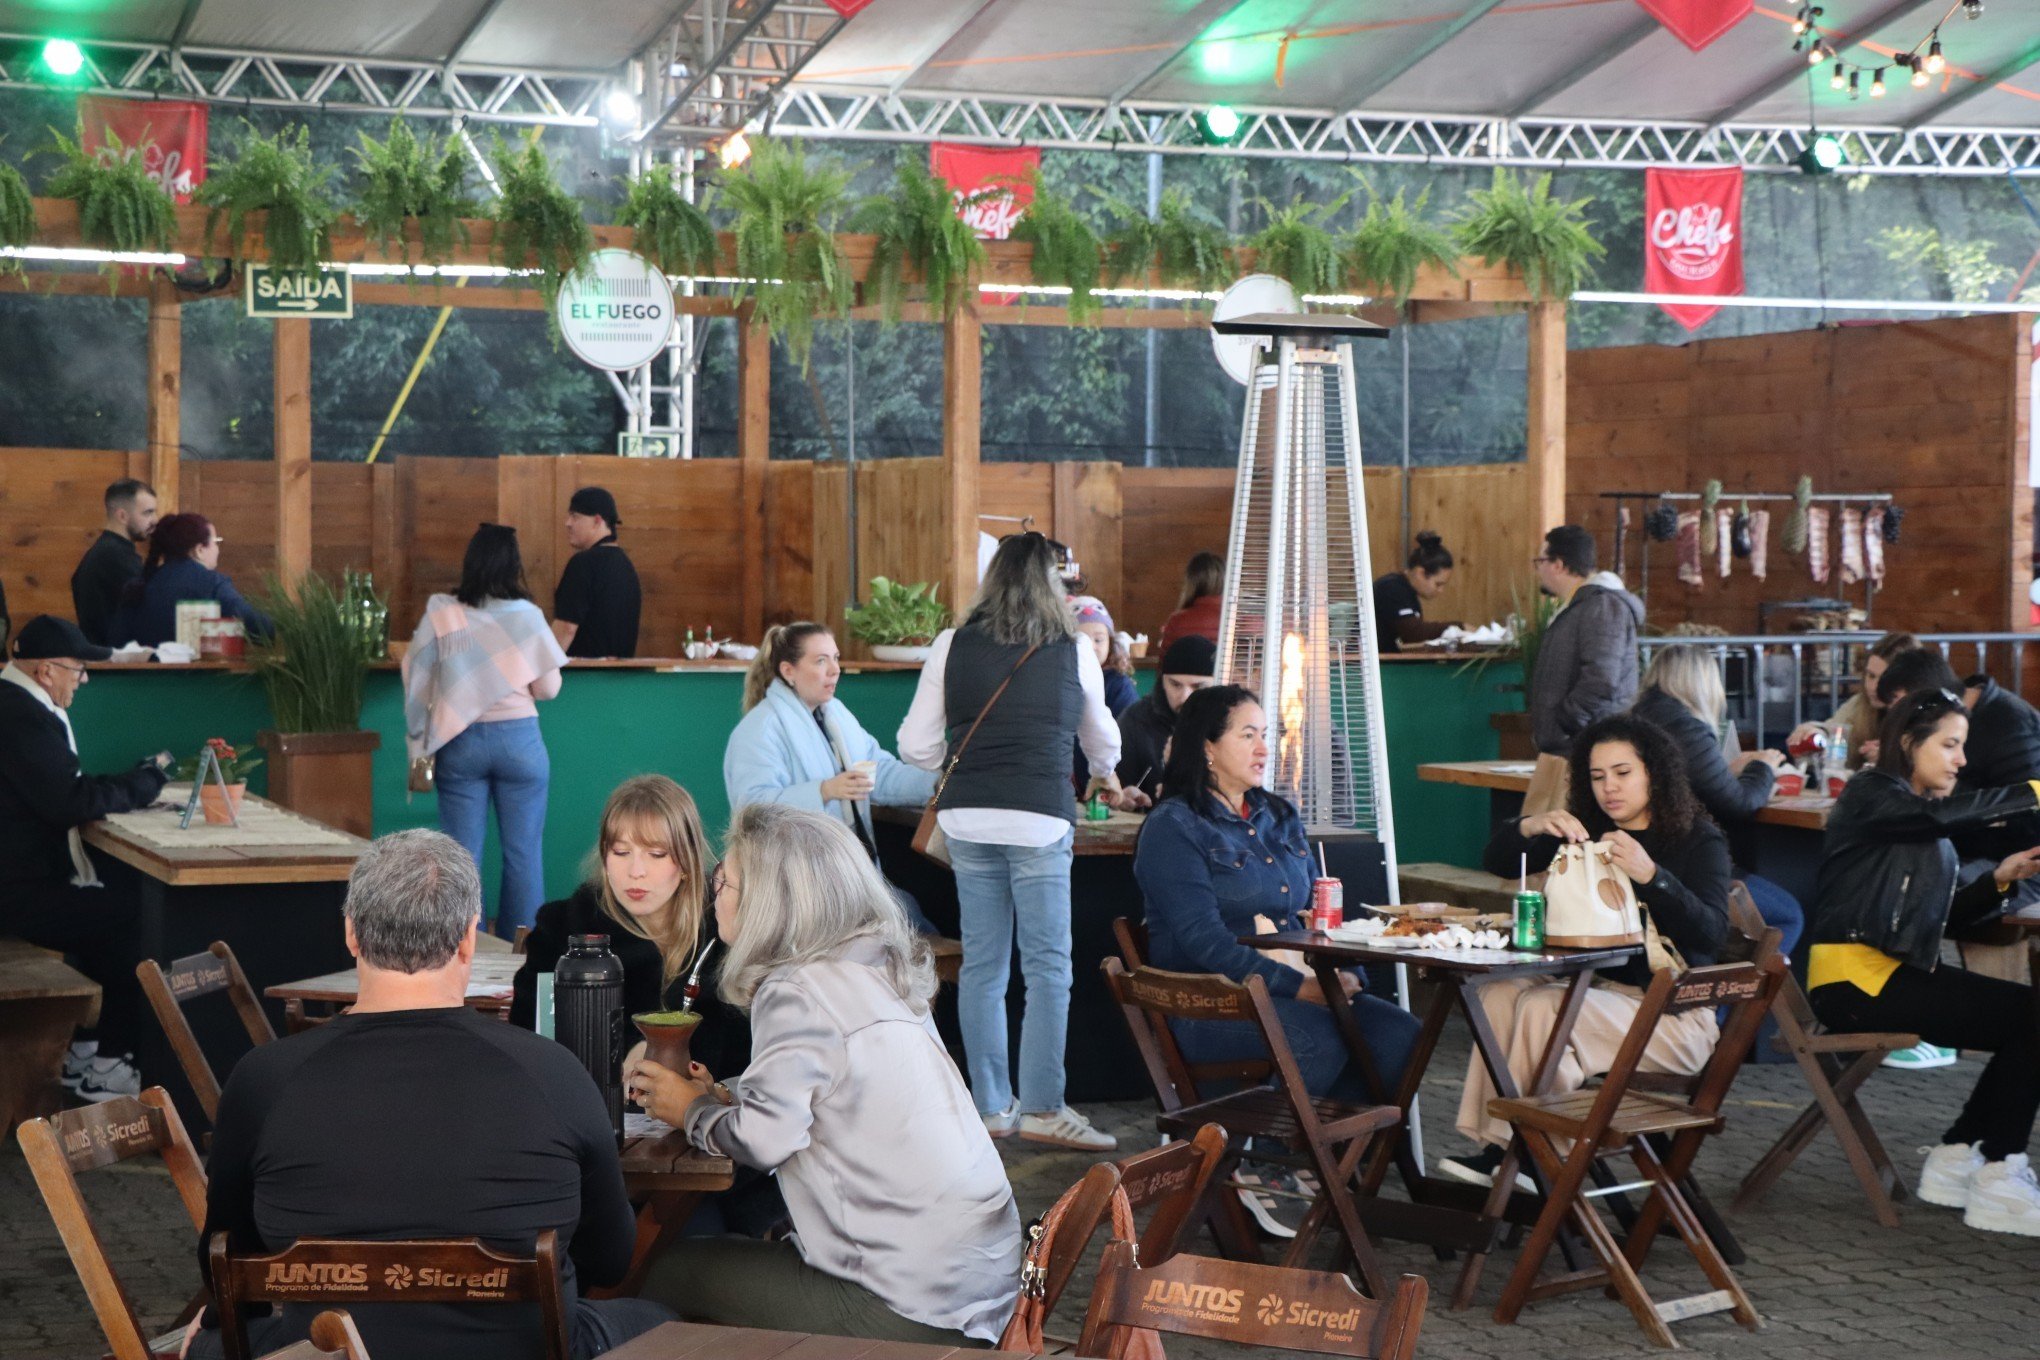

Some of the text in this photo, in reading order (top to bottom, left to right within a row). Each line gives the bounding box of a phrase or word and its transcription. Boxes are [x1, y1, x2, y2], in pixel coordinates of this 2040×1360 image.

[1651, 206, 1734, 257] Chefs
[571, 303, 661, 320] EL FUEGO
[1191, 994, 1238, 1008] Sicredi
[107, 1114, 150, 1142] Sicredi
[265, 1263, 368, 1283] JUNTOS
[417, 1268, 509, 1287] Sicredi
[265, 1283, 310, 1292] Programa
[311, 1283, 322, 1291] de
[1143, 1279, 1245, 1313] JUNTOS
[1195, 1310, 1240, 1323] Fidelidade
[1286, 1301, 1361, 1331] Sicredi
